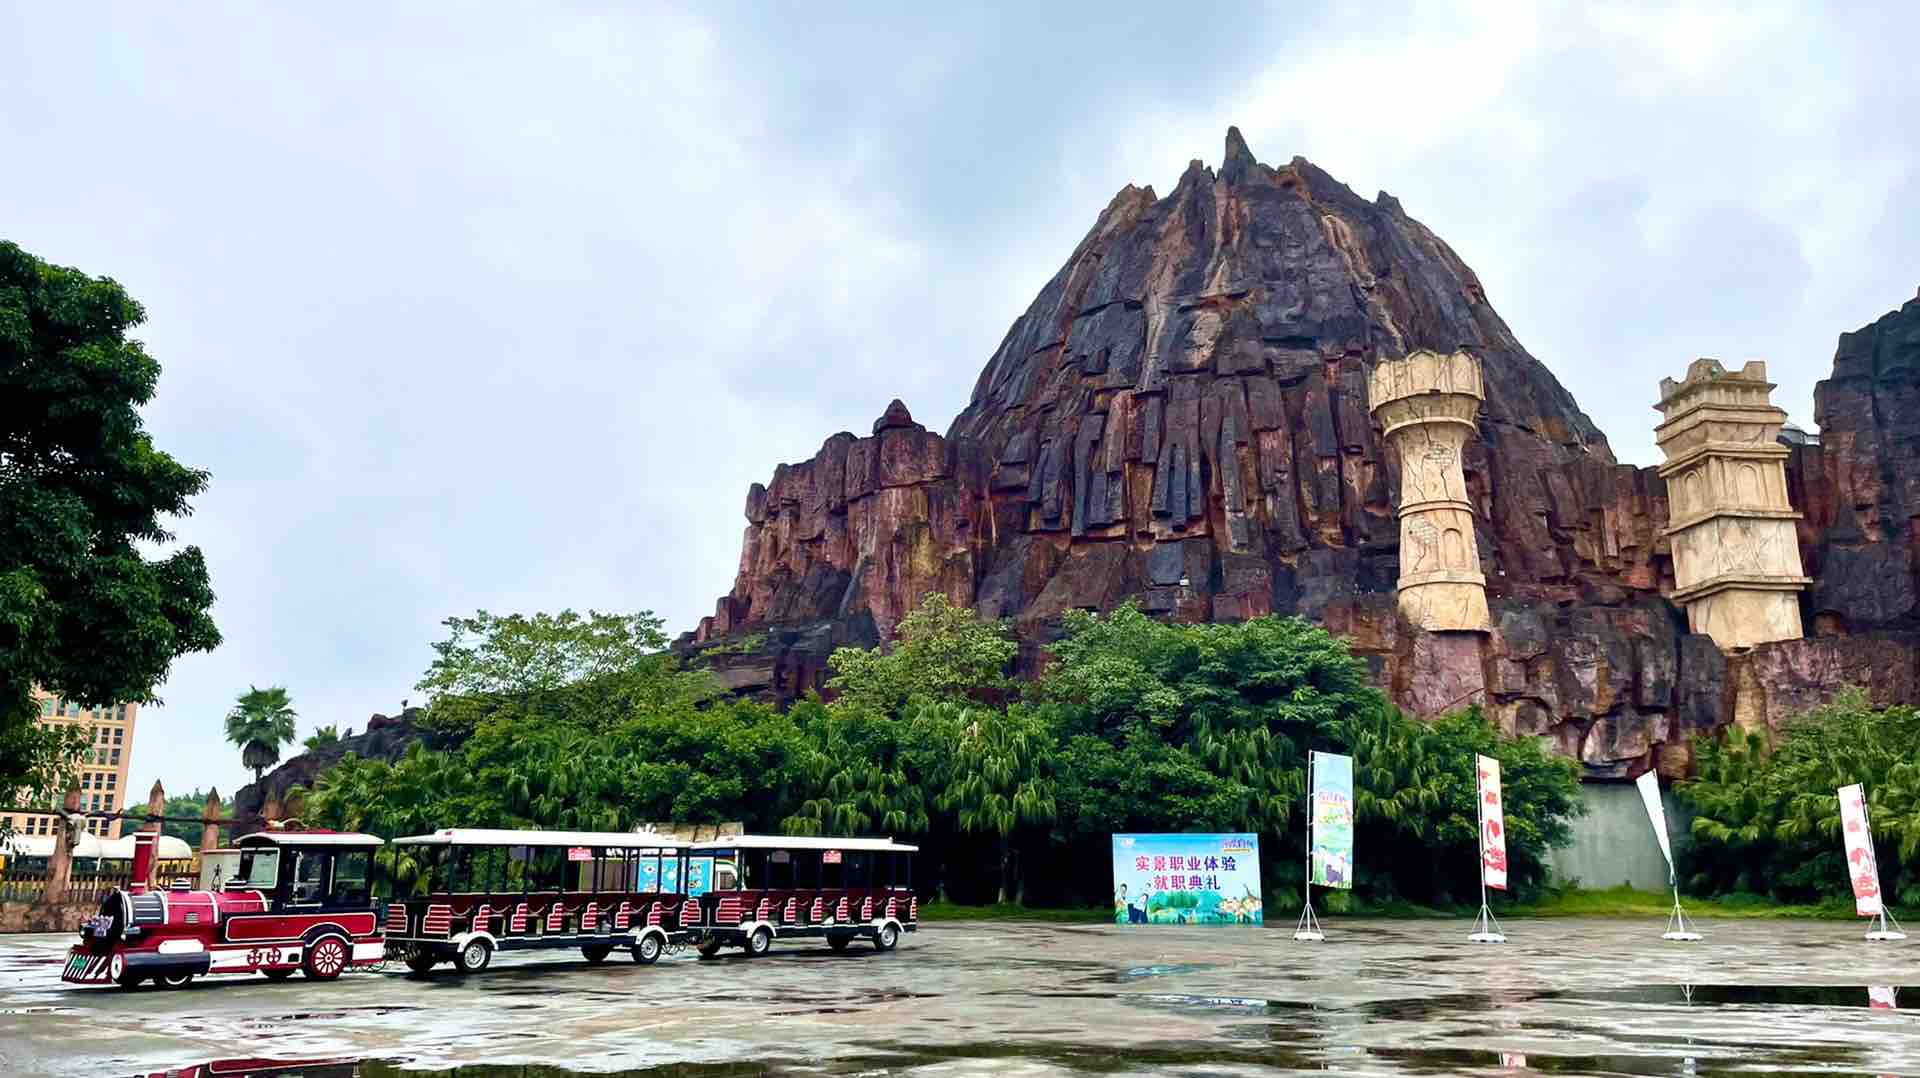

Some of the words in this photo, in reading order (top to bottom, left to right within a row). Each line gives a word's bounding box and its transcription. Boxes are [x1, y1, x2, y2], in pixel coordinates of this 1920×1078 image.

[1135, 856, 1237, 872] 实景职业体验
[1153, 875, 1222, 890] 就职典礼
